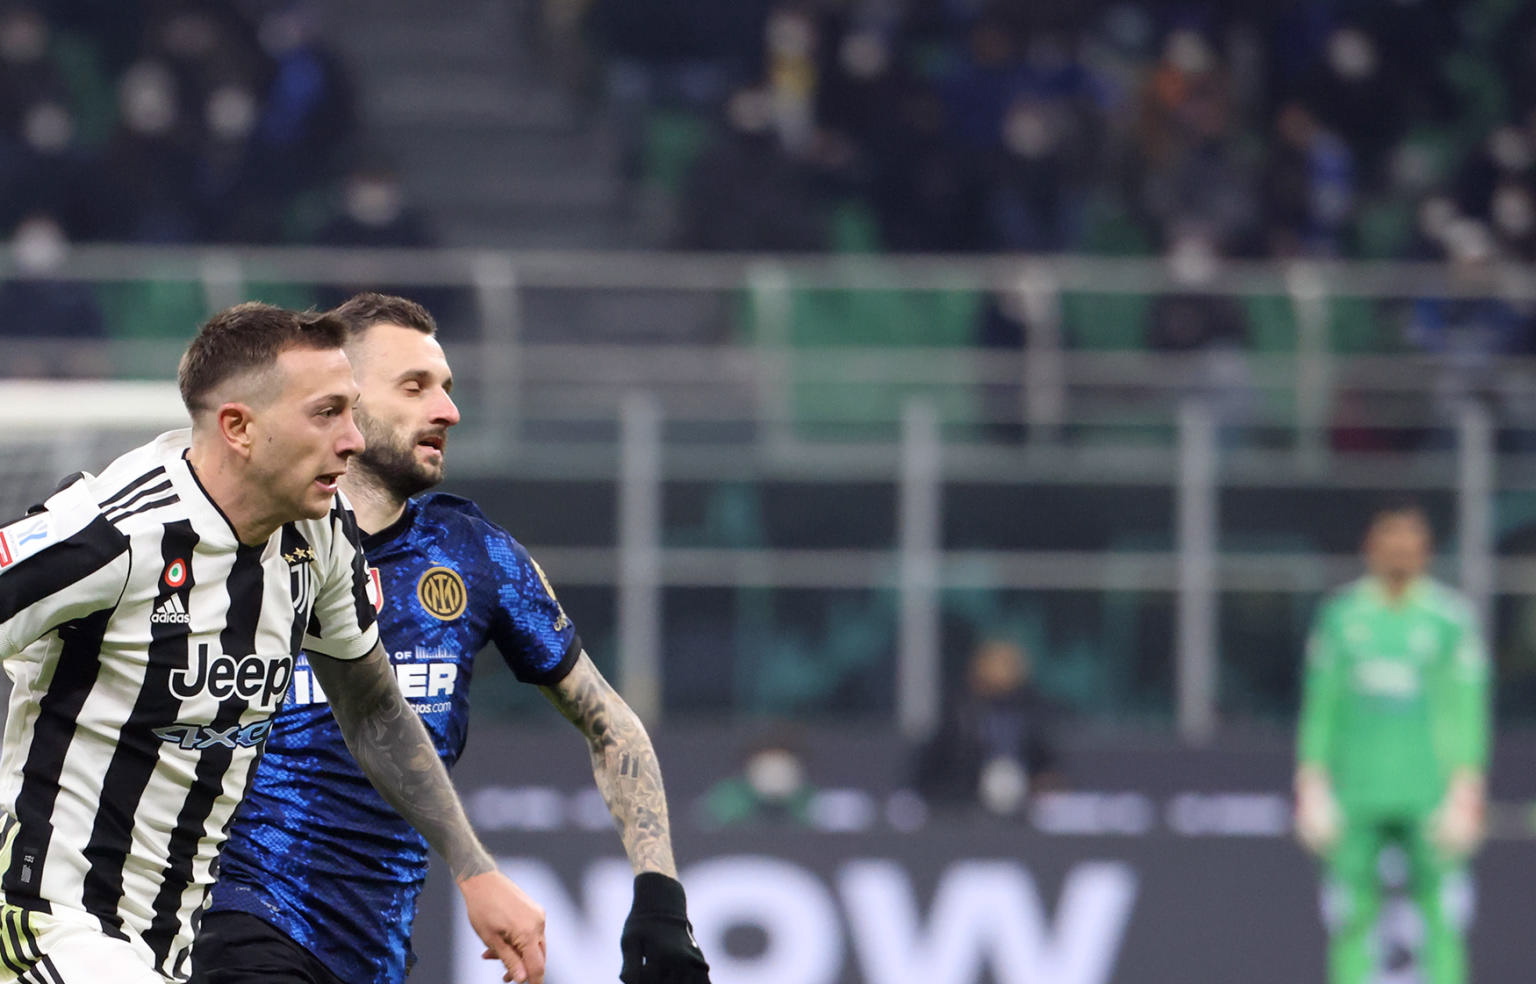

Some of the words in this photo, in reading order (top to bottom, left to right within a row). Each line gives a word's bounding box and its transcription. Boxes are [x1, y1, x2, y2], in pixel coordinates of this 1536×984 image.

[151, 612, 190, 623] adidas
[395, 651, 412, 660] OF
[169, 640, 292, 707] Jeep
[294, 663, 458, 704] IER
